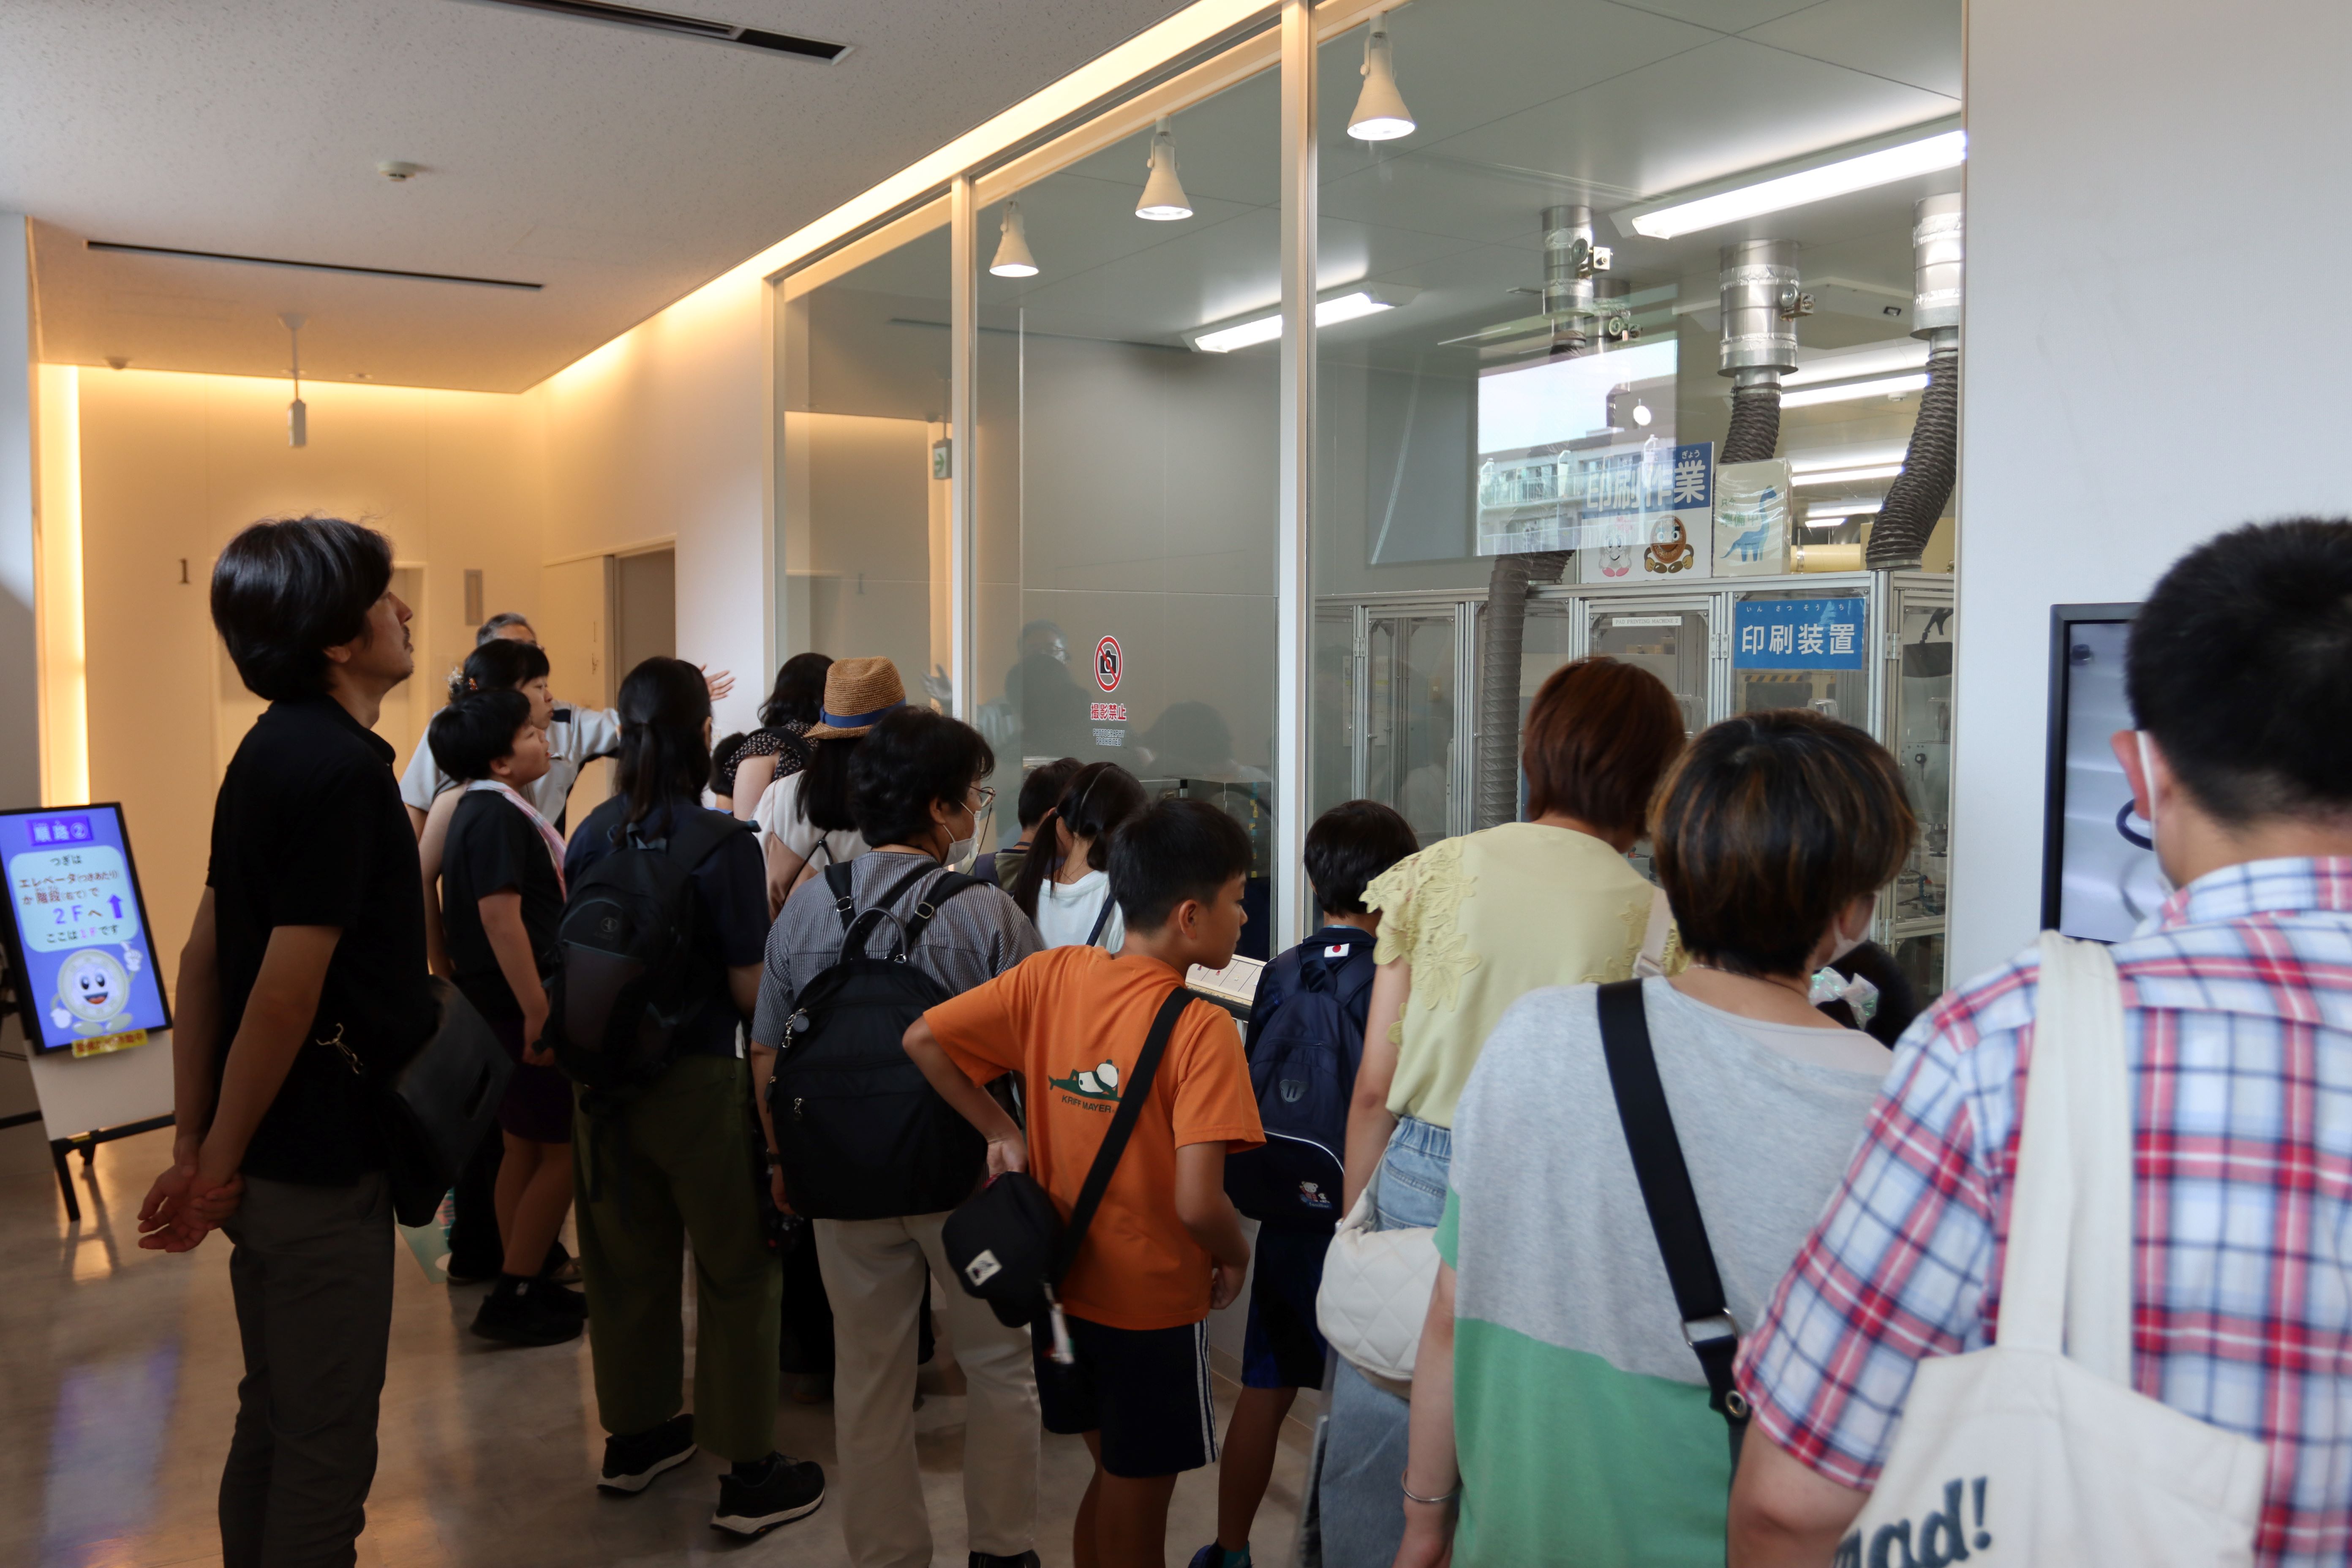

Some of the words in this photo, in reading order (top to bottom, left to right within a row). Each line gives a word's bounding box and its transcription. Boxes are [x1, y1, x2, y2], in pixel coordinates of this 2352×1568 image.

[1682, 450, 1700, 459] ぎょう
[1587, 460, 1706, 512] 印刷作業
[178, 558, 191, 585] 1
[1742, 623, 1855, 655] 印刷装置
[1091, 703, 1127, 721] 撮影禁止
[1093, 729, 1125, 738] PHOTOGRAPHY
[1096, 737, 1122, 746] PROHIBITED
[50, 855, 82, 866] つぎは
[1062, 1094, 1081, 1107] KRIFF
[1082, 1101, 1111, 1113] MAYER
